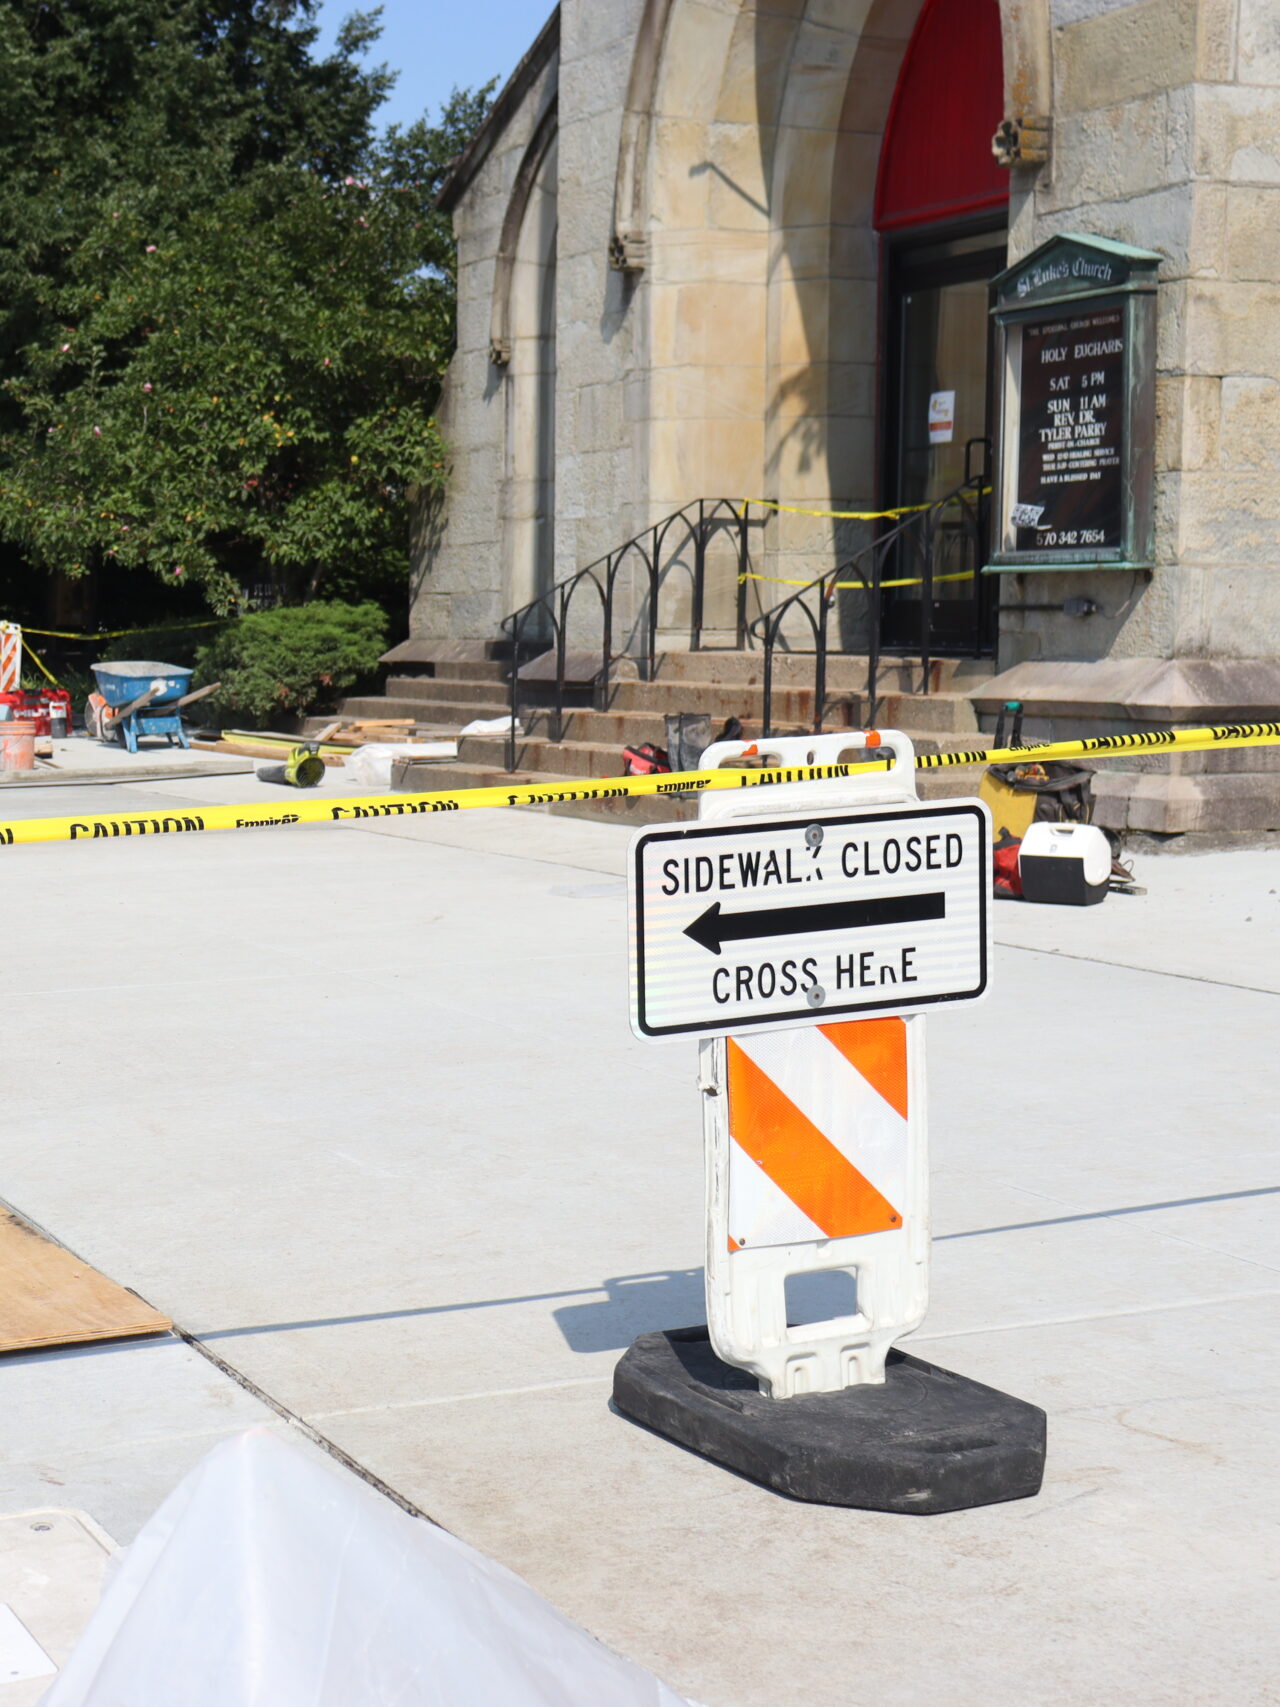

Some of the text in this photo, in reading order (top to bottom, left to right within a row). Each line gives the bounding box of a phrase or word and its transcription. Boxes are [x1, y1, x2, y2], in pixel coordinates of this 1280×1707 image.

[1033, 261, 1069, 287] Luke's
[1072, 257, 1112, 281] Church
[1041, 347, 1068, 364] HOLY
[1050, 371, 1105, 391] SAT 5 PM
[1047, 393, 1106, 414] SUN 11 AM
[1039, 422, 1107, 442] TYLER PARRY
[1040, 475, 1058, 484] HAVE
[1089, 471, 1101, 480] DAY
[1036, 530, 1105, 546] 570 342 7654
[841, 832, 963, 878] CLOSED
[712, 957, 818, 1004] CROSS
